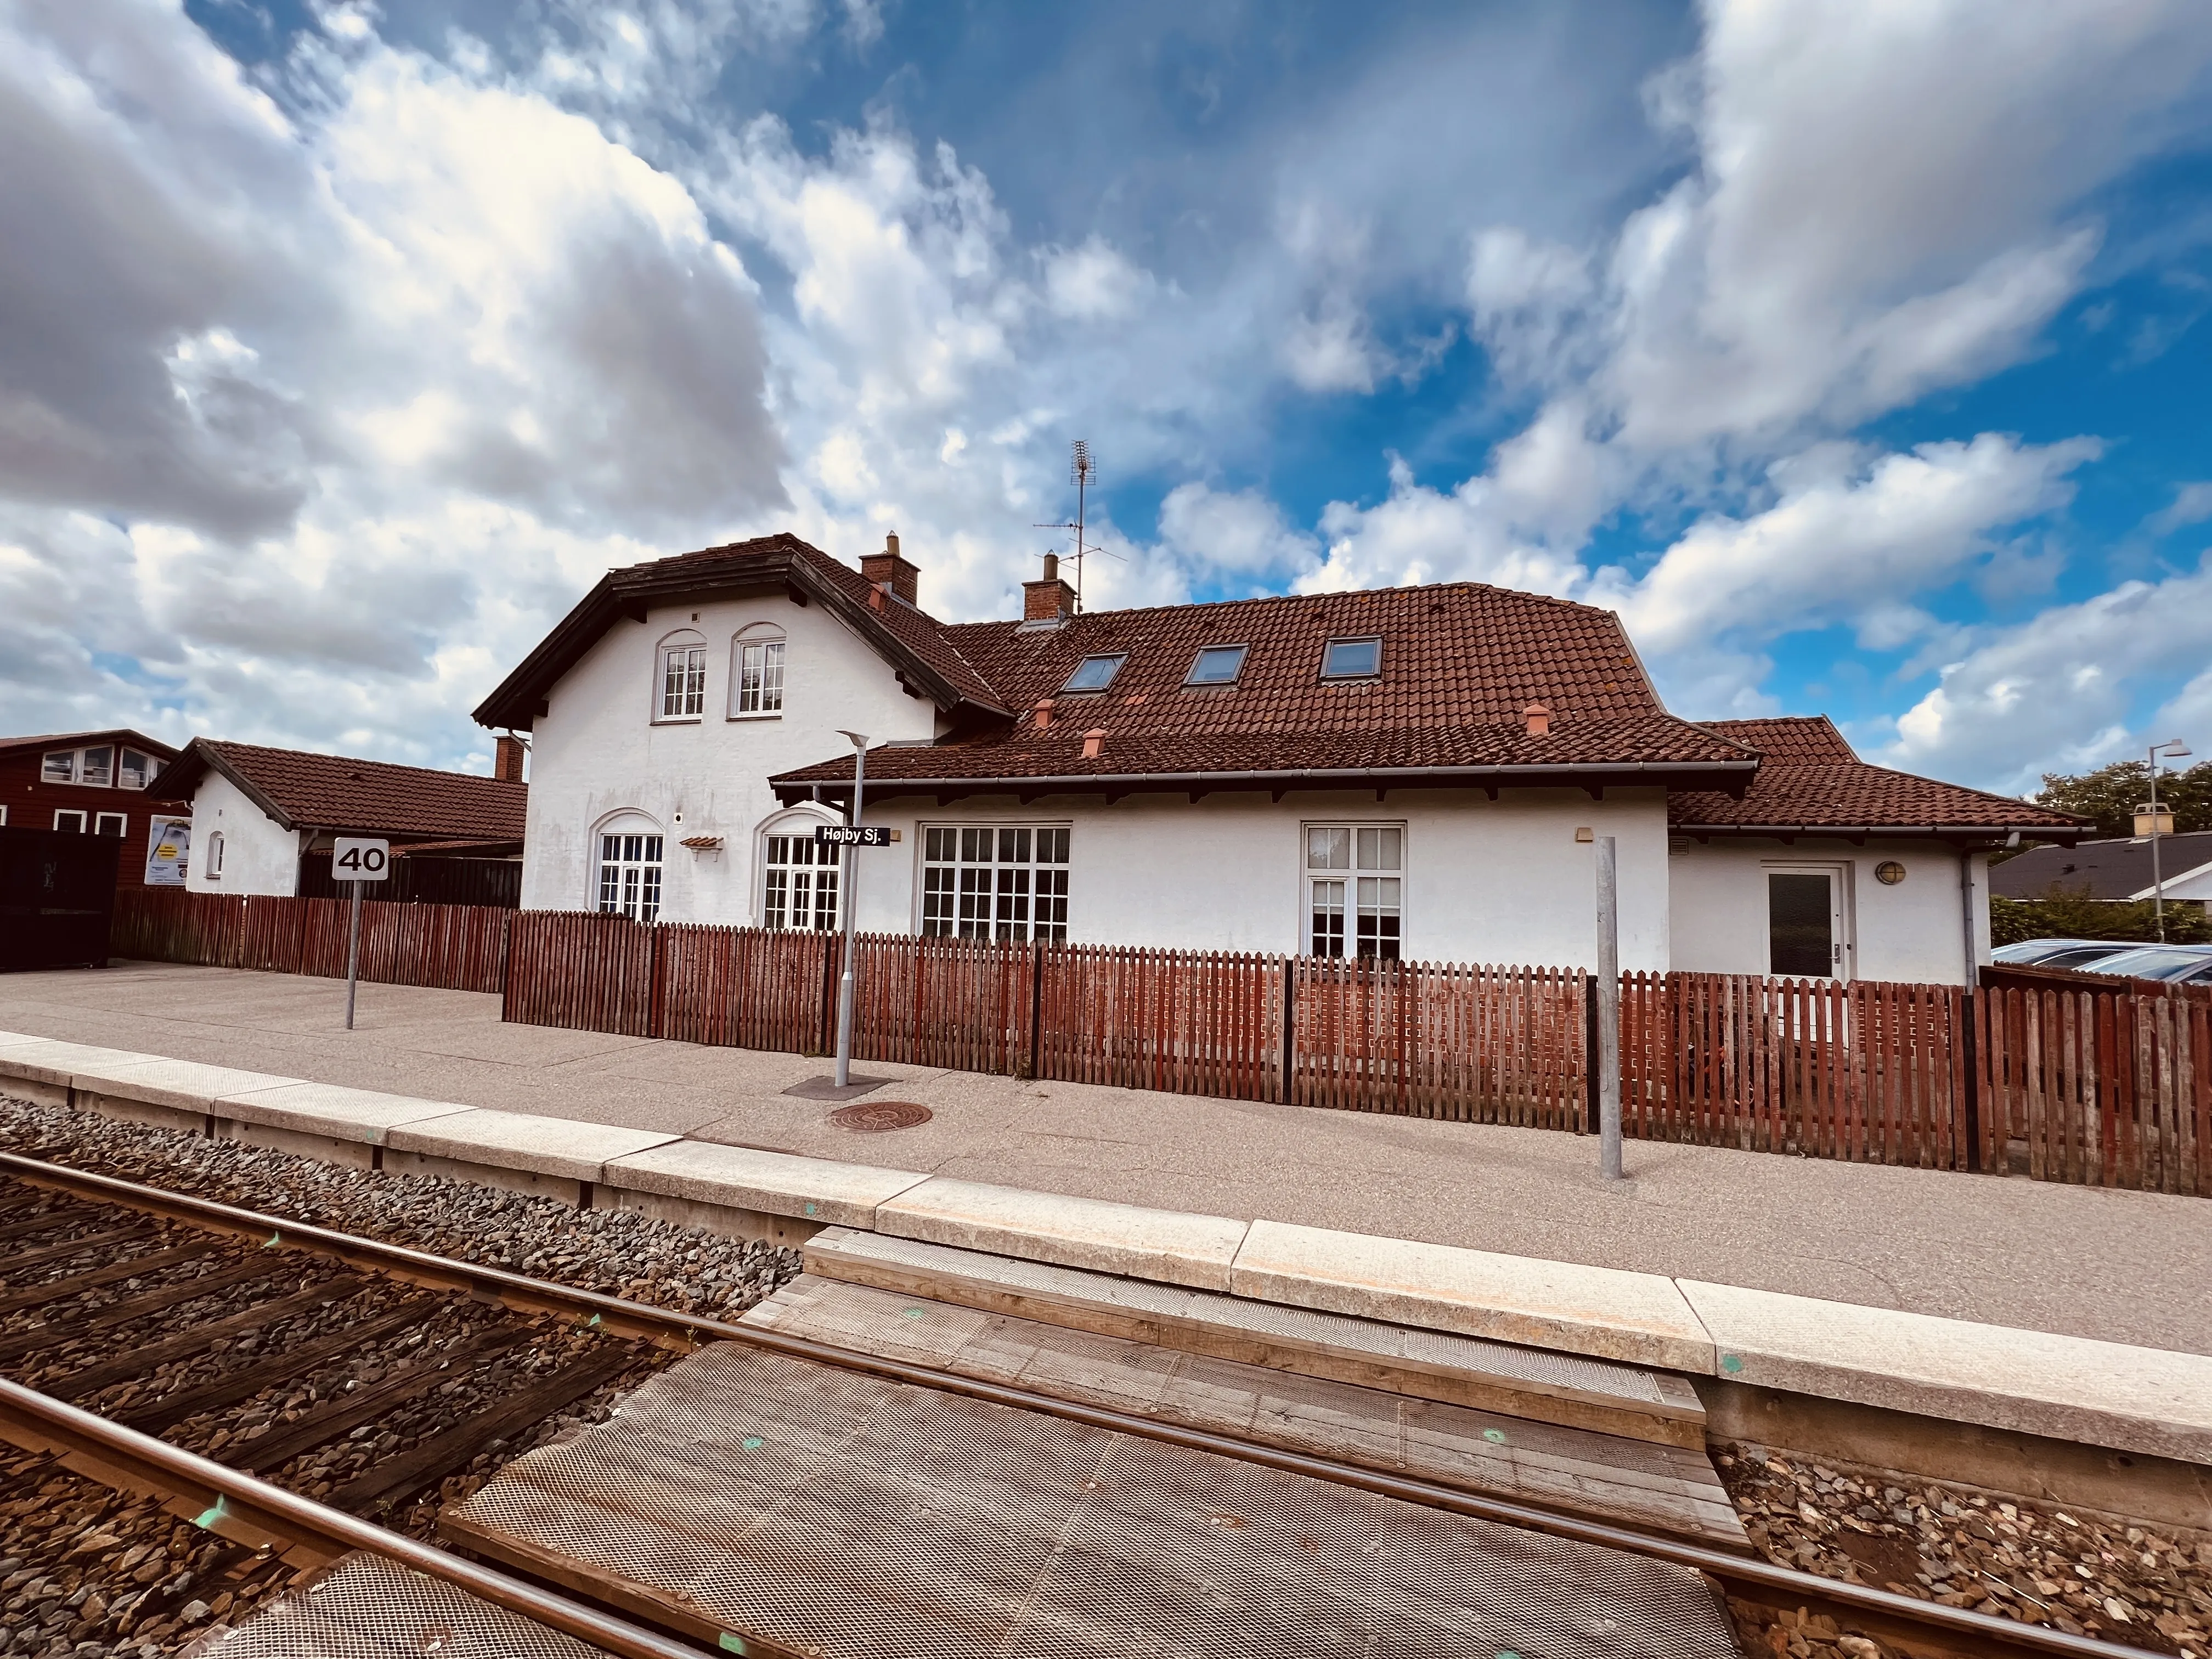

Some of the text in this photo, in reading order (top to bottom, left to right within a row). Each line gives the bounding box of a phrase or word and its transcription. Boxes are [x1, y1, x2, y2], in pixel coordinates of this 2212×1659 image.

[823, 827, 881, 844] Højby Sj.
[338, 848, 385, 872] 40
